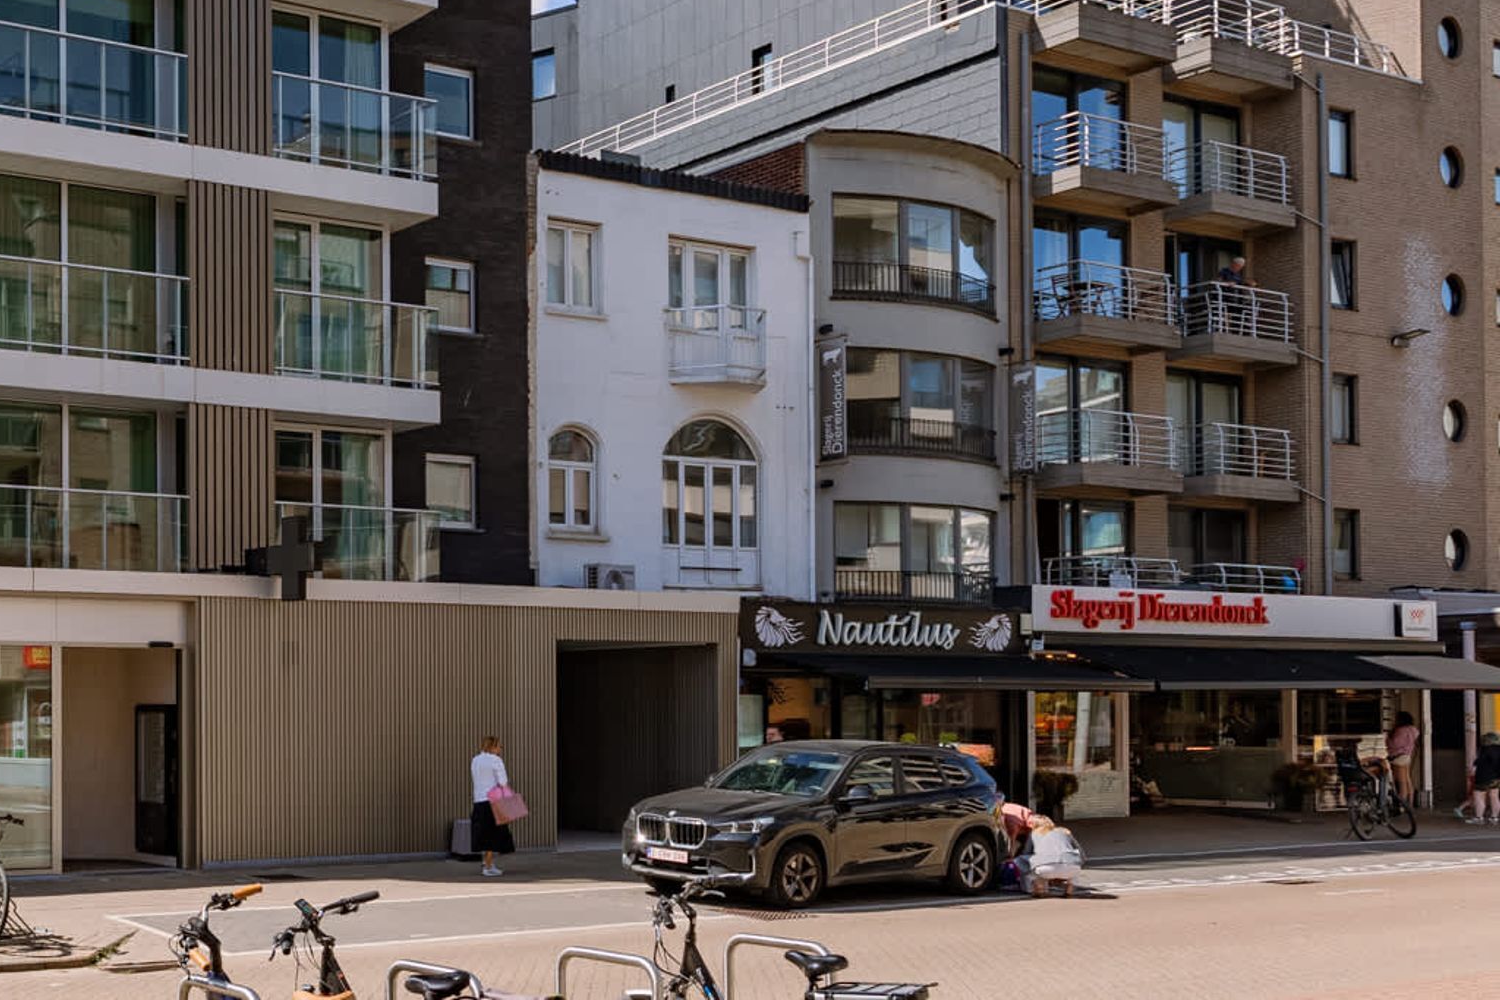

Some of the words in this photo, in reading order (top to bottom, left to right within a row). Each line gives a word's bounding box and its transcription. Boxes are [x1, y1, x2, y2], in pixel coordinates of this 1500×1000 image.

[832, 371, 843, 454] Dierendonck
[816, 609, 961, 650] Nautilus
[1050, 590, 1134, 629] Slagerij
[1138, 593, 1269, 624] Dierendonck
